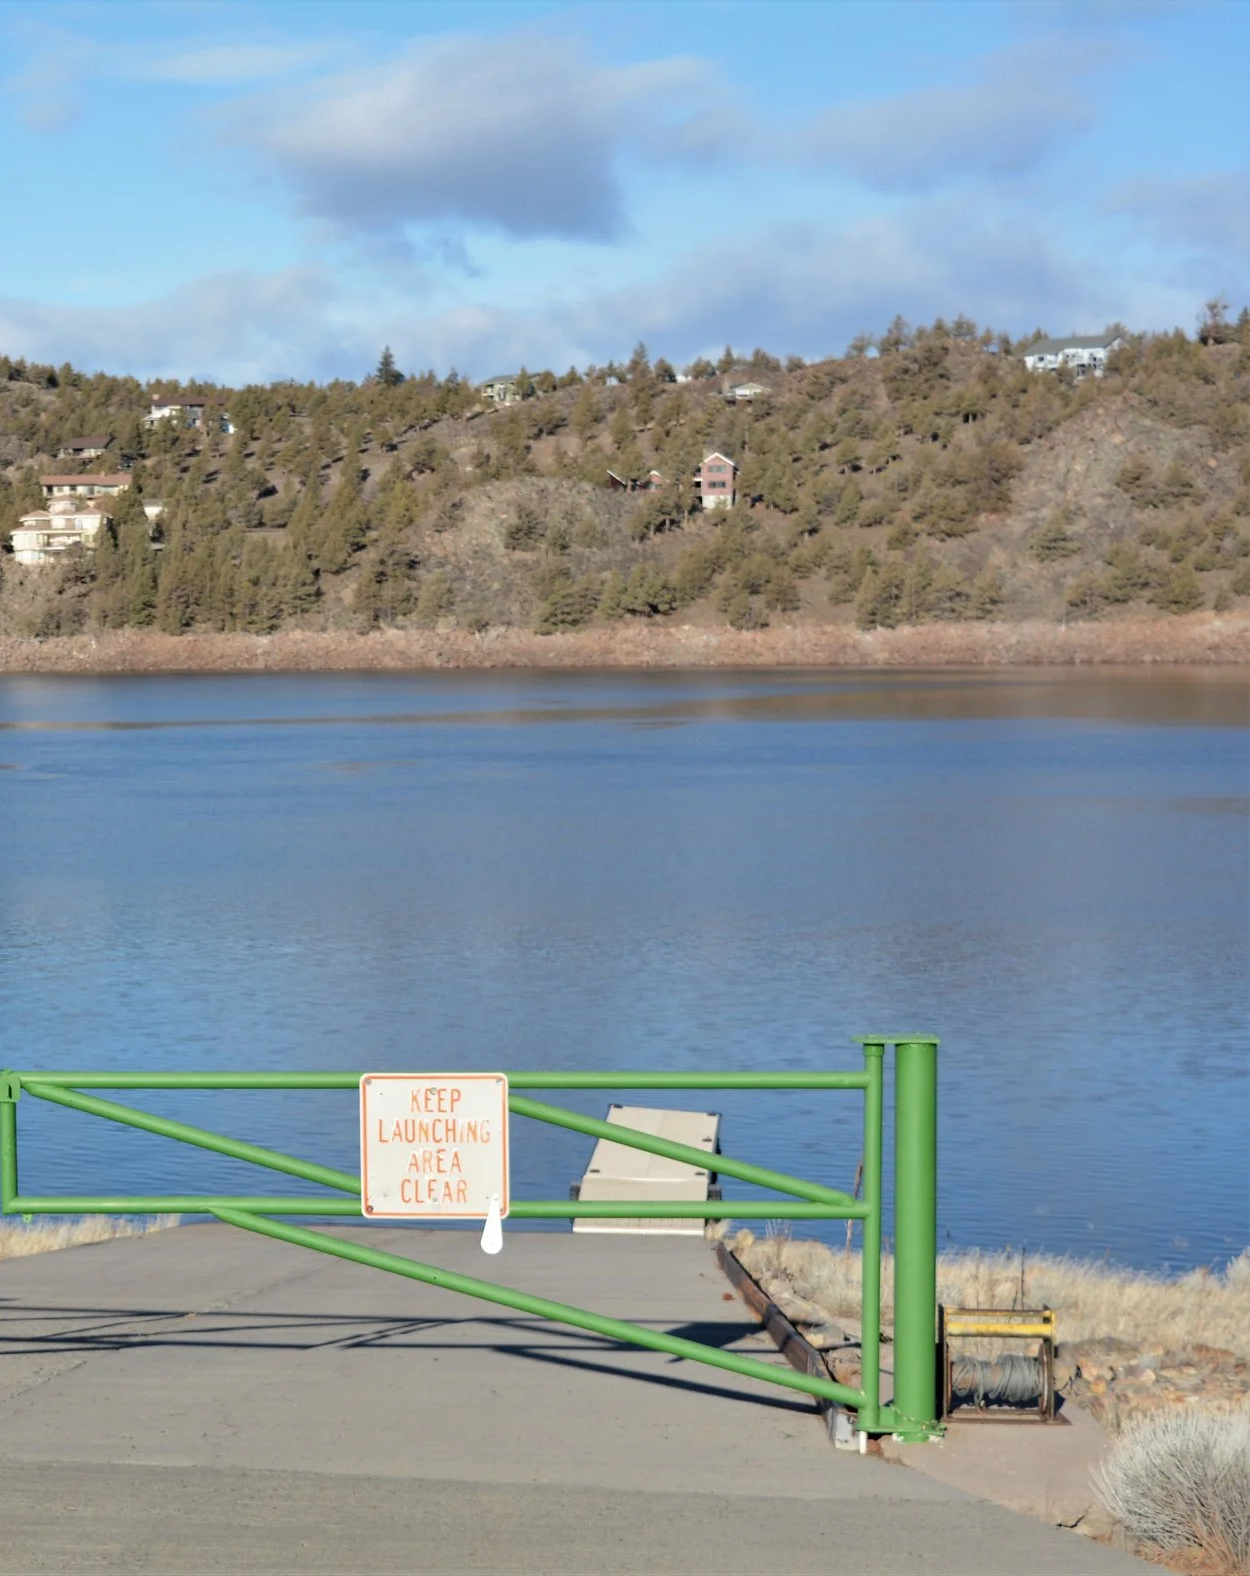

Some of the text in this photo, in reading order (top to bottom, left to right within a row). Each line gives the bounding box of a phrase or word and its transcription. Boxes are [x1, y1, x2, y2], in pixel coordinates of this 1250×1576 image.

[410, 1088, 462, 1113] KEEP
[378, 1118, 491, 1144] LAUNCHING
[407, 1148, 462, 1174] AREA
[400, 1178, 468, 1204] CLEAR
